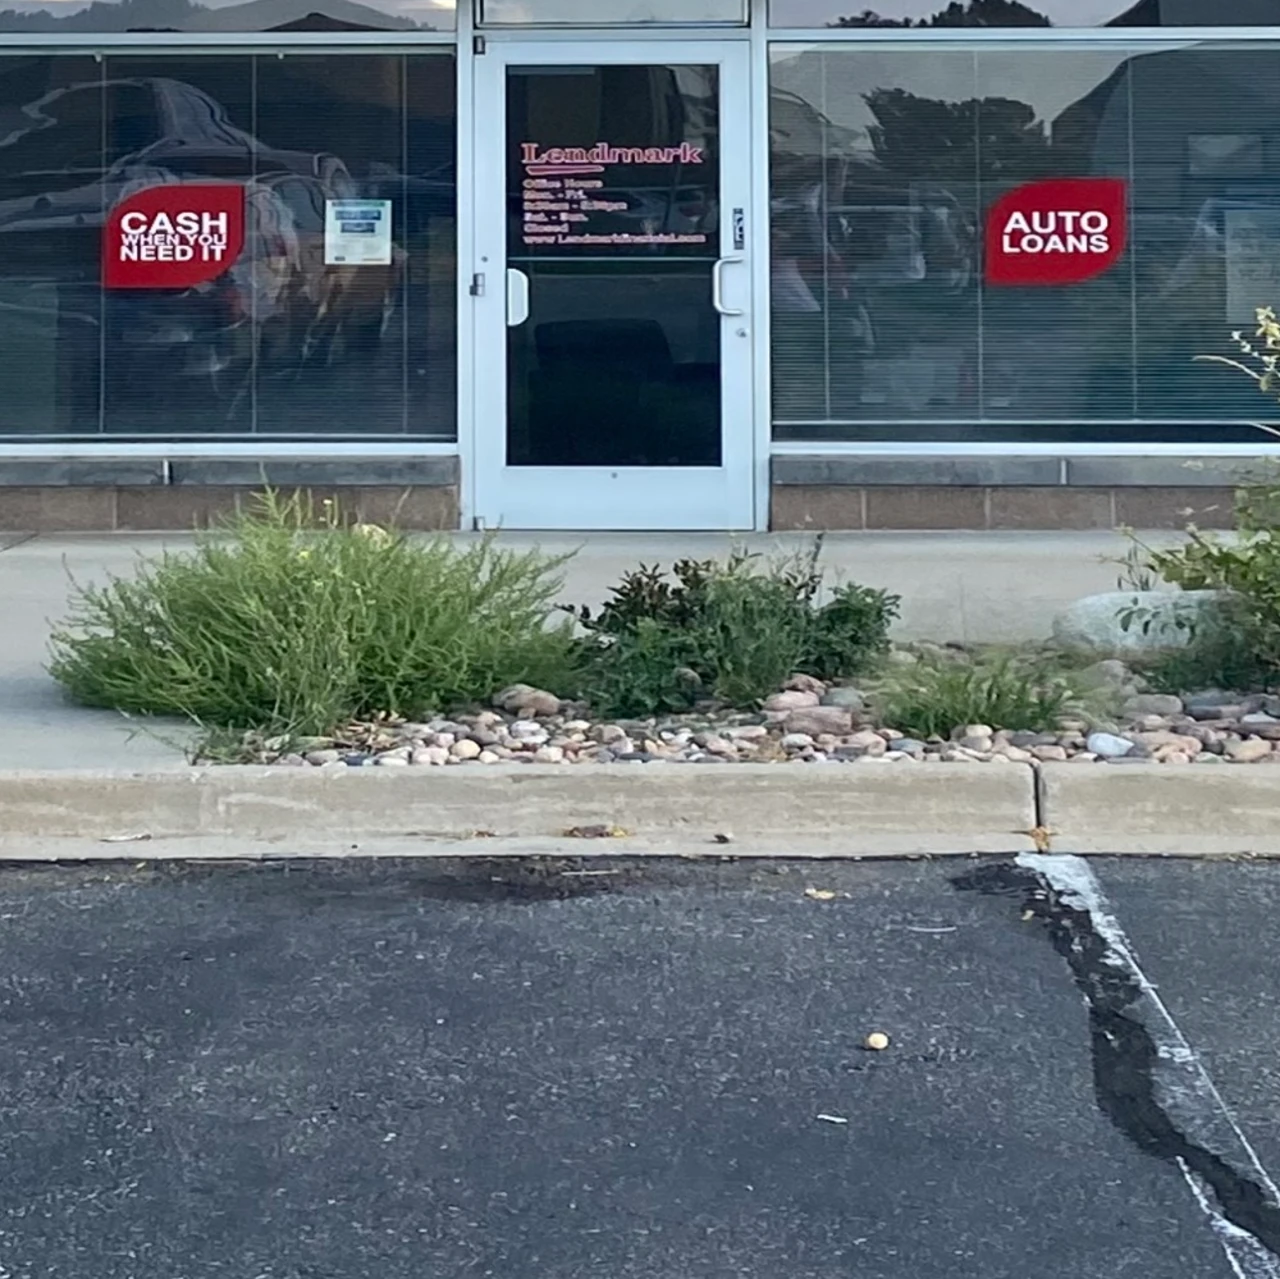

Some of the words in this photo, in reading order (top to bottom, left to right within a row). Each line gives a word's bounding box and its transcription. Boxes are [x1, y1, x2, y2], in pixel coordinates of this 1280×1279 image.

[521, 141, 703, 164] Lendmark
[121, 211, 228, 234] CASH
[1003, 211, 1109, 234] AUTO
[121, 234, 180, 246] WHEN
[185, 234, 227, 246] YOU
[1002, 234, 1110, 254] LOANS
[121, 245, 194, 262] NEED
[202, 245, 227, 262] IT
